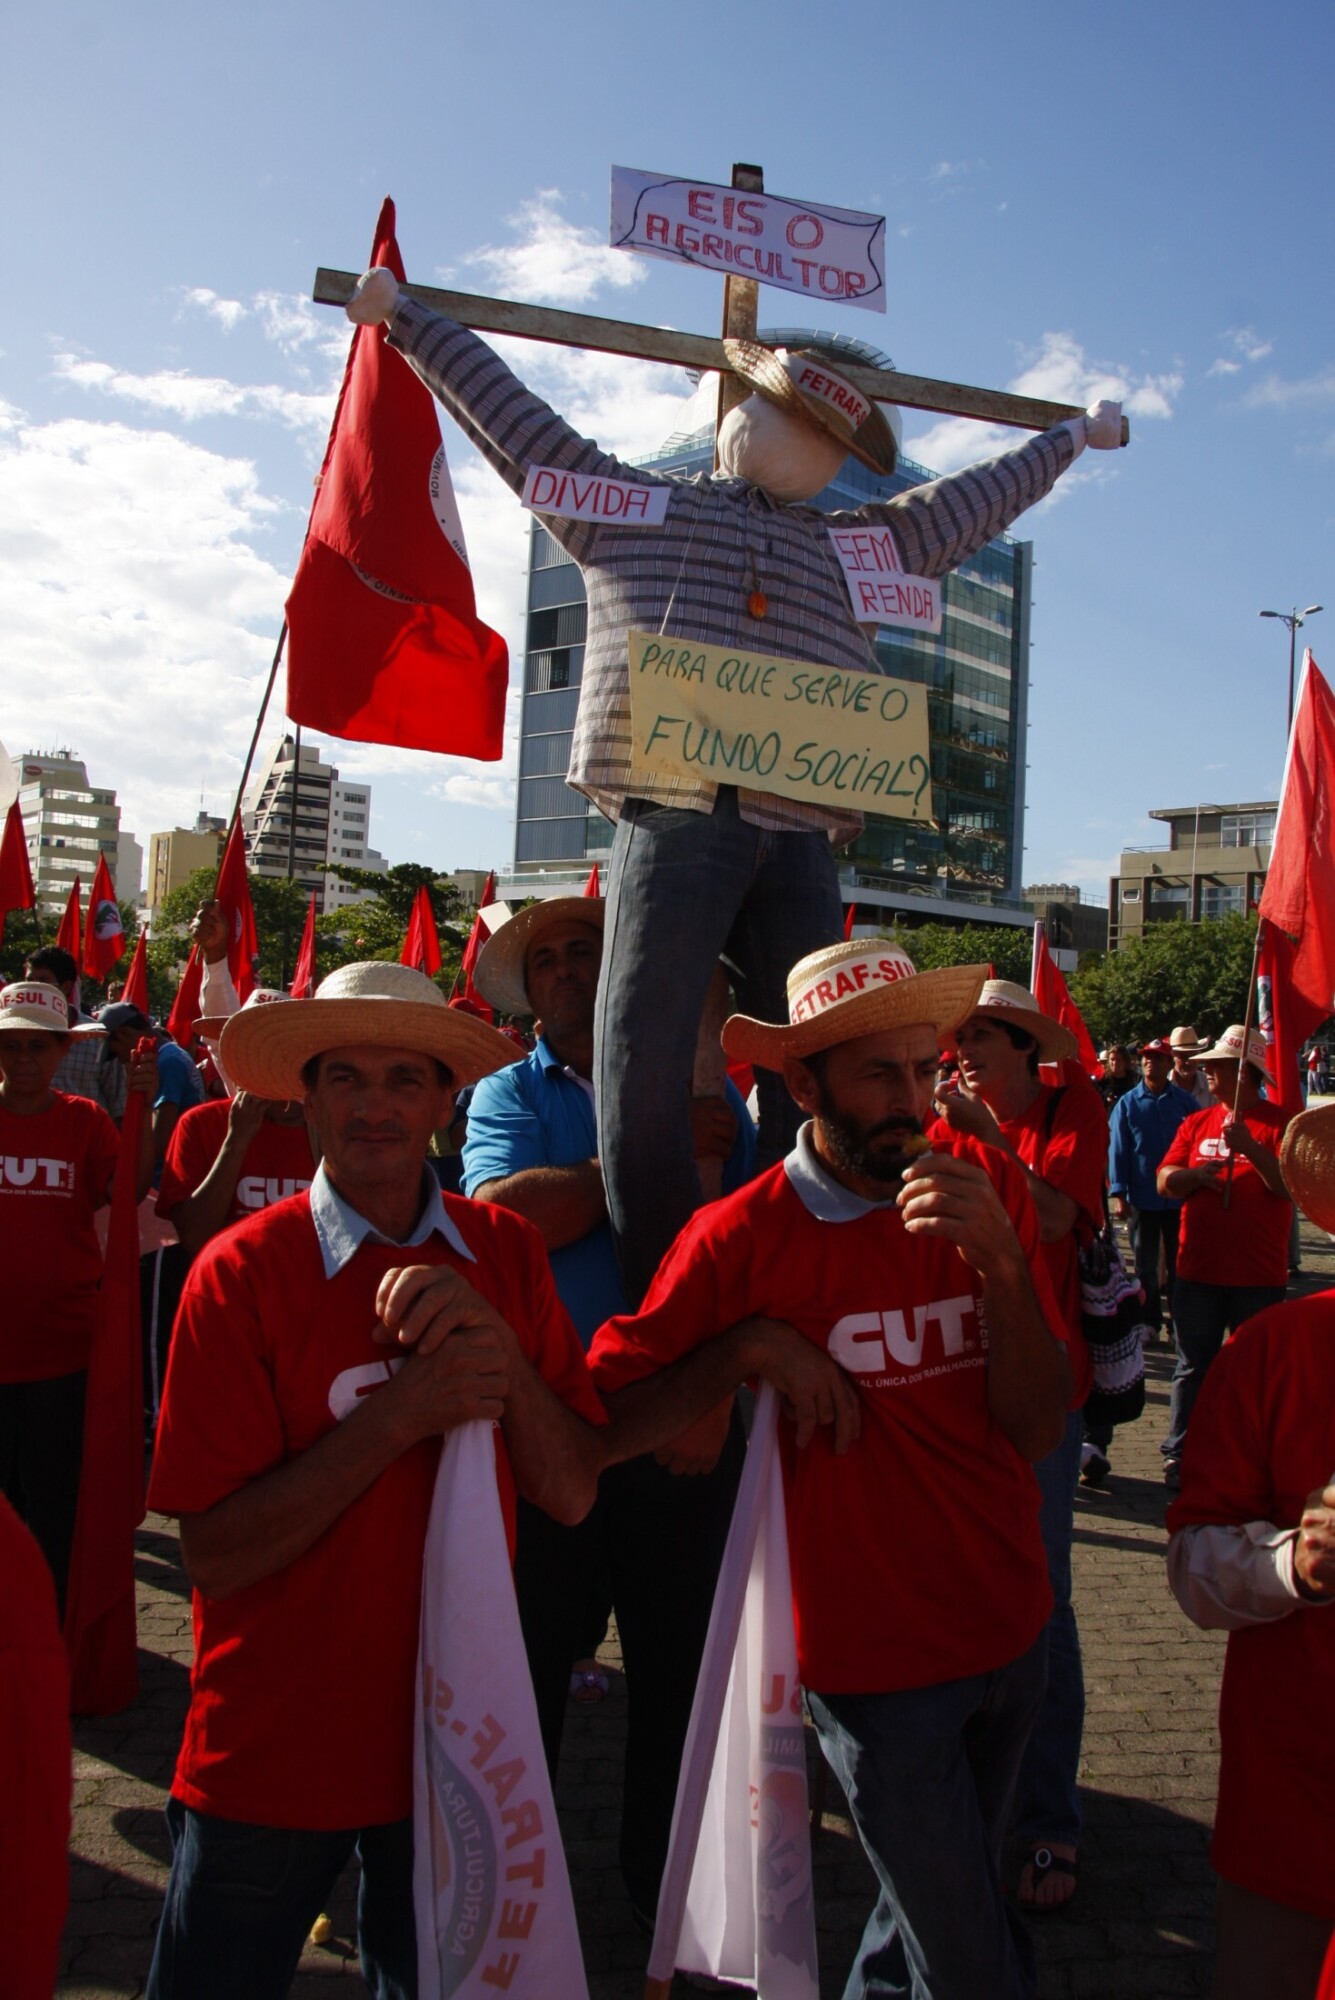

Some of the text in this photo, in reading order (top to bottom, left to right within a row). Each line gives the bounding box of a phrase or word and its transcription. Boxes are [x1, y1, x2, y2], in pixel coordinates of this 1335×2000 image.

[688, 189, 824, 250] EIS O
[646, 213, 866, 298] AGRICULTOR
[799, 367, 868, 427] FETRAF-S
[833, 532, 898, 572] SEM
[858, 581, 933, 621] RENDA
[639, 643, 706, 683] PARA
[716, 658, 777, 697] QUE
[645, 715, 781, 776] FUNDO
[0, 1155, 67, 1187] UT
[828, 1295, 974, 1373] CUT
